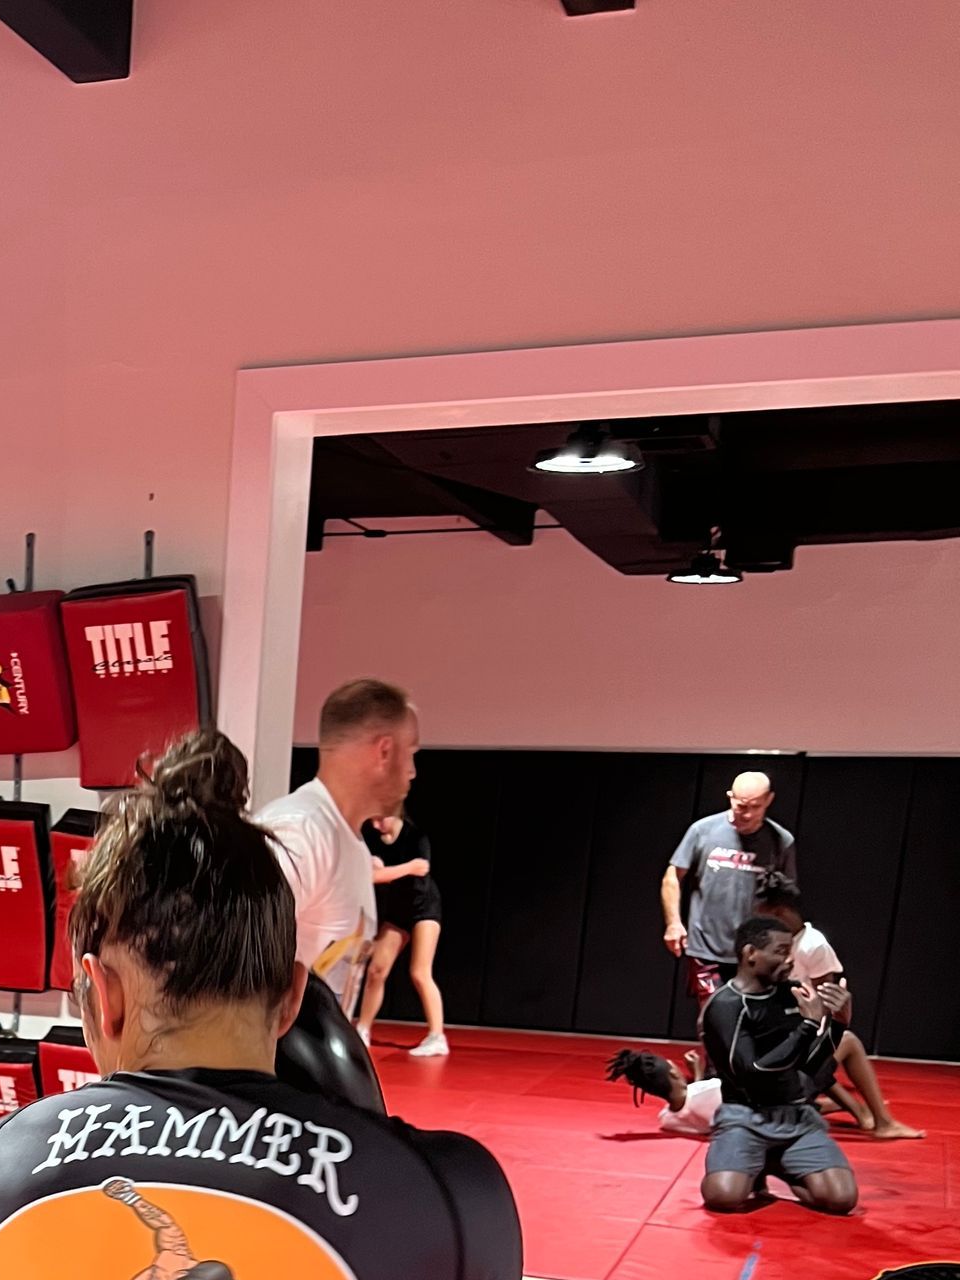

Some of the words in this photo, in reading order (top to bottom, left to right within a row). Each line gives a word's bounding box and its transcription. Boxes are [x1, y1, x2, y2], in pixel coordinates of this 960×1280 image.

[84, 620, 173, 675] TITLE
[10, 658, 29, 714] CENTURY
[32, 1103, 359, 1217] HAMMER
